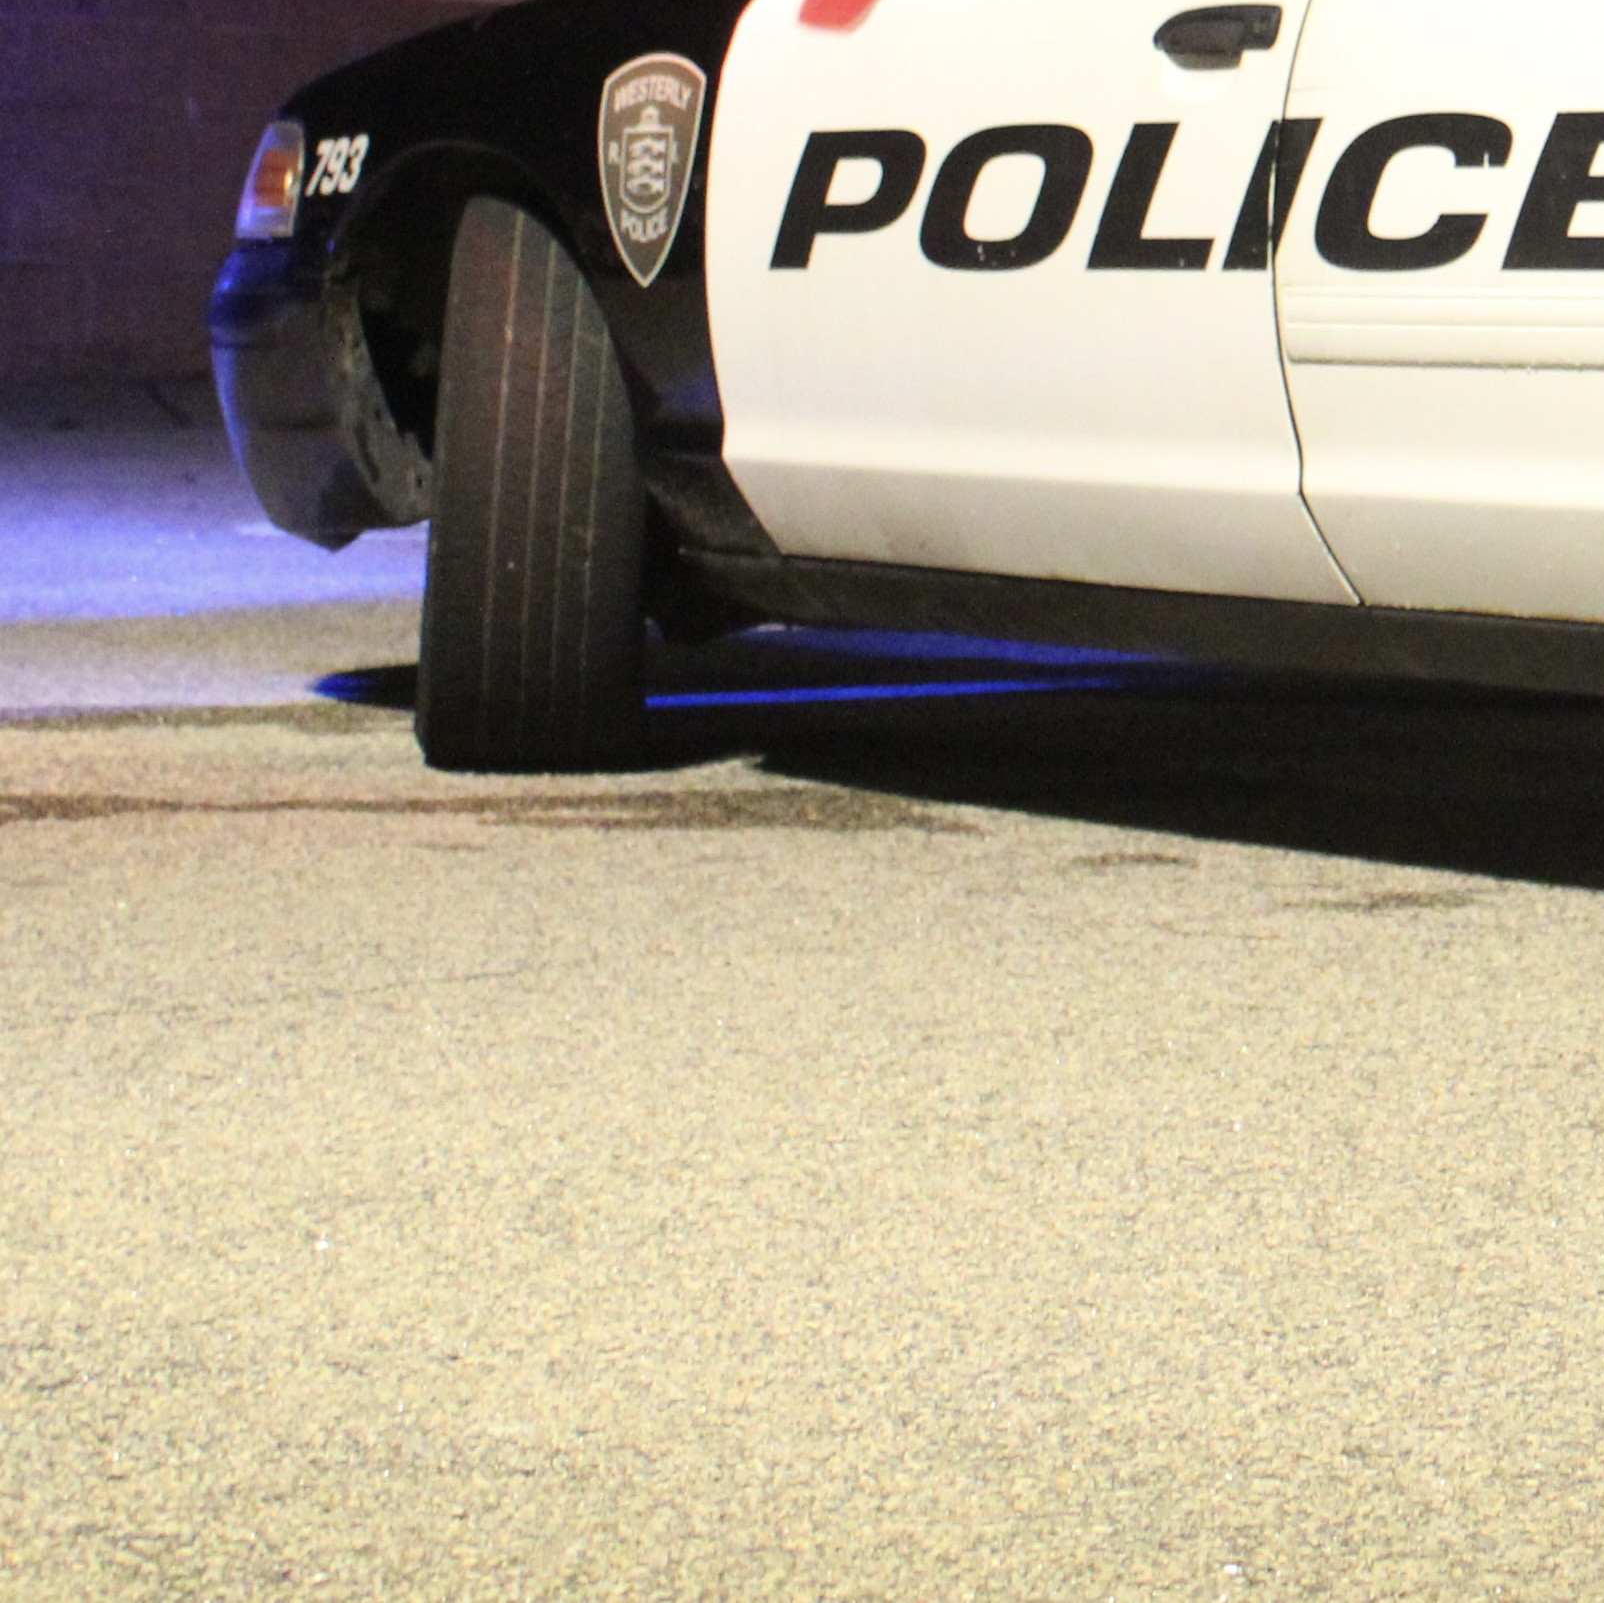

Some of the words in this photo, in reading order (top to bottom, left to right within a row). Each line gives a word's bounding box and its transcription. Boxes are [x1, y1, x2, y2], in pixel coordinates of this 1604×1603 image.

[613, 73, 692, 113] WESTERLY
[305, 133, 370, 197] 793
[619, 205, 669, 244] POLICE
